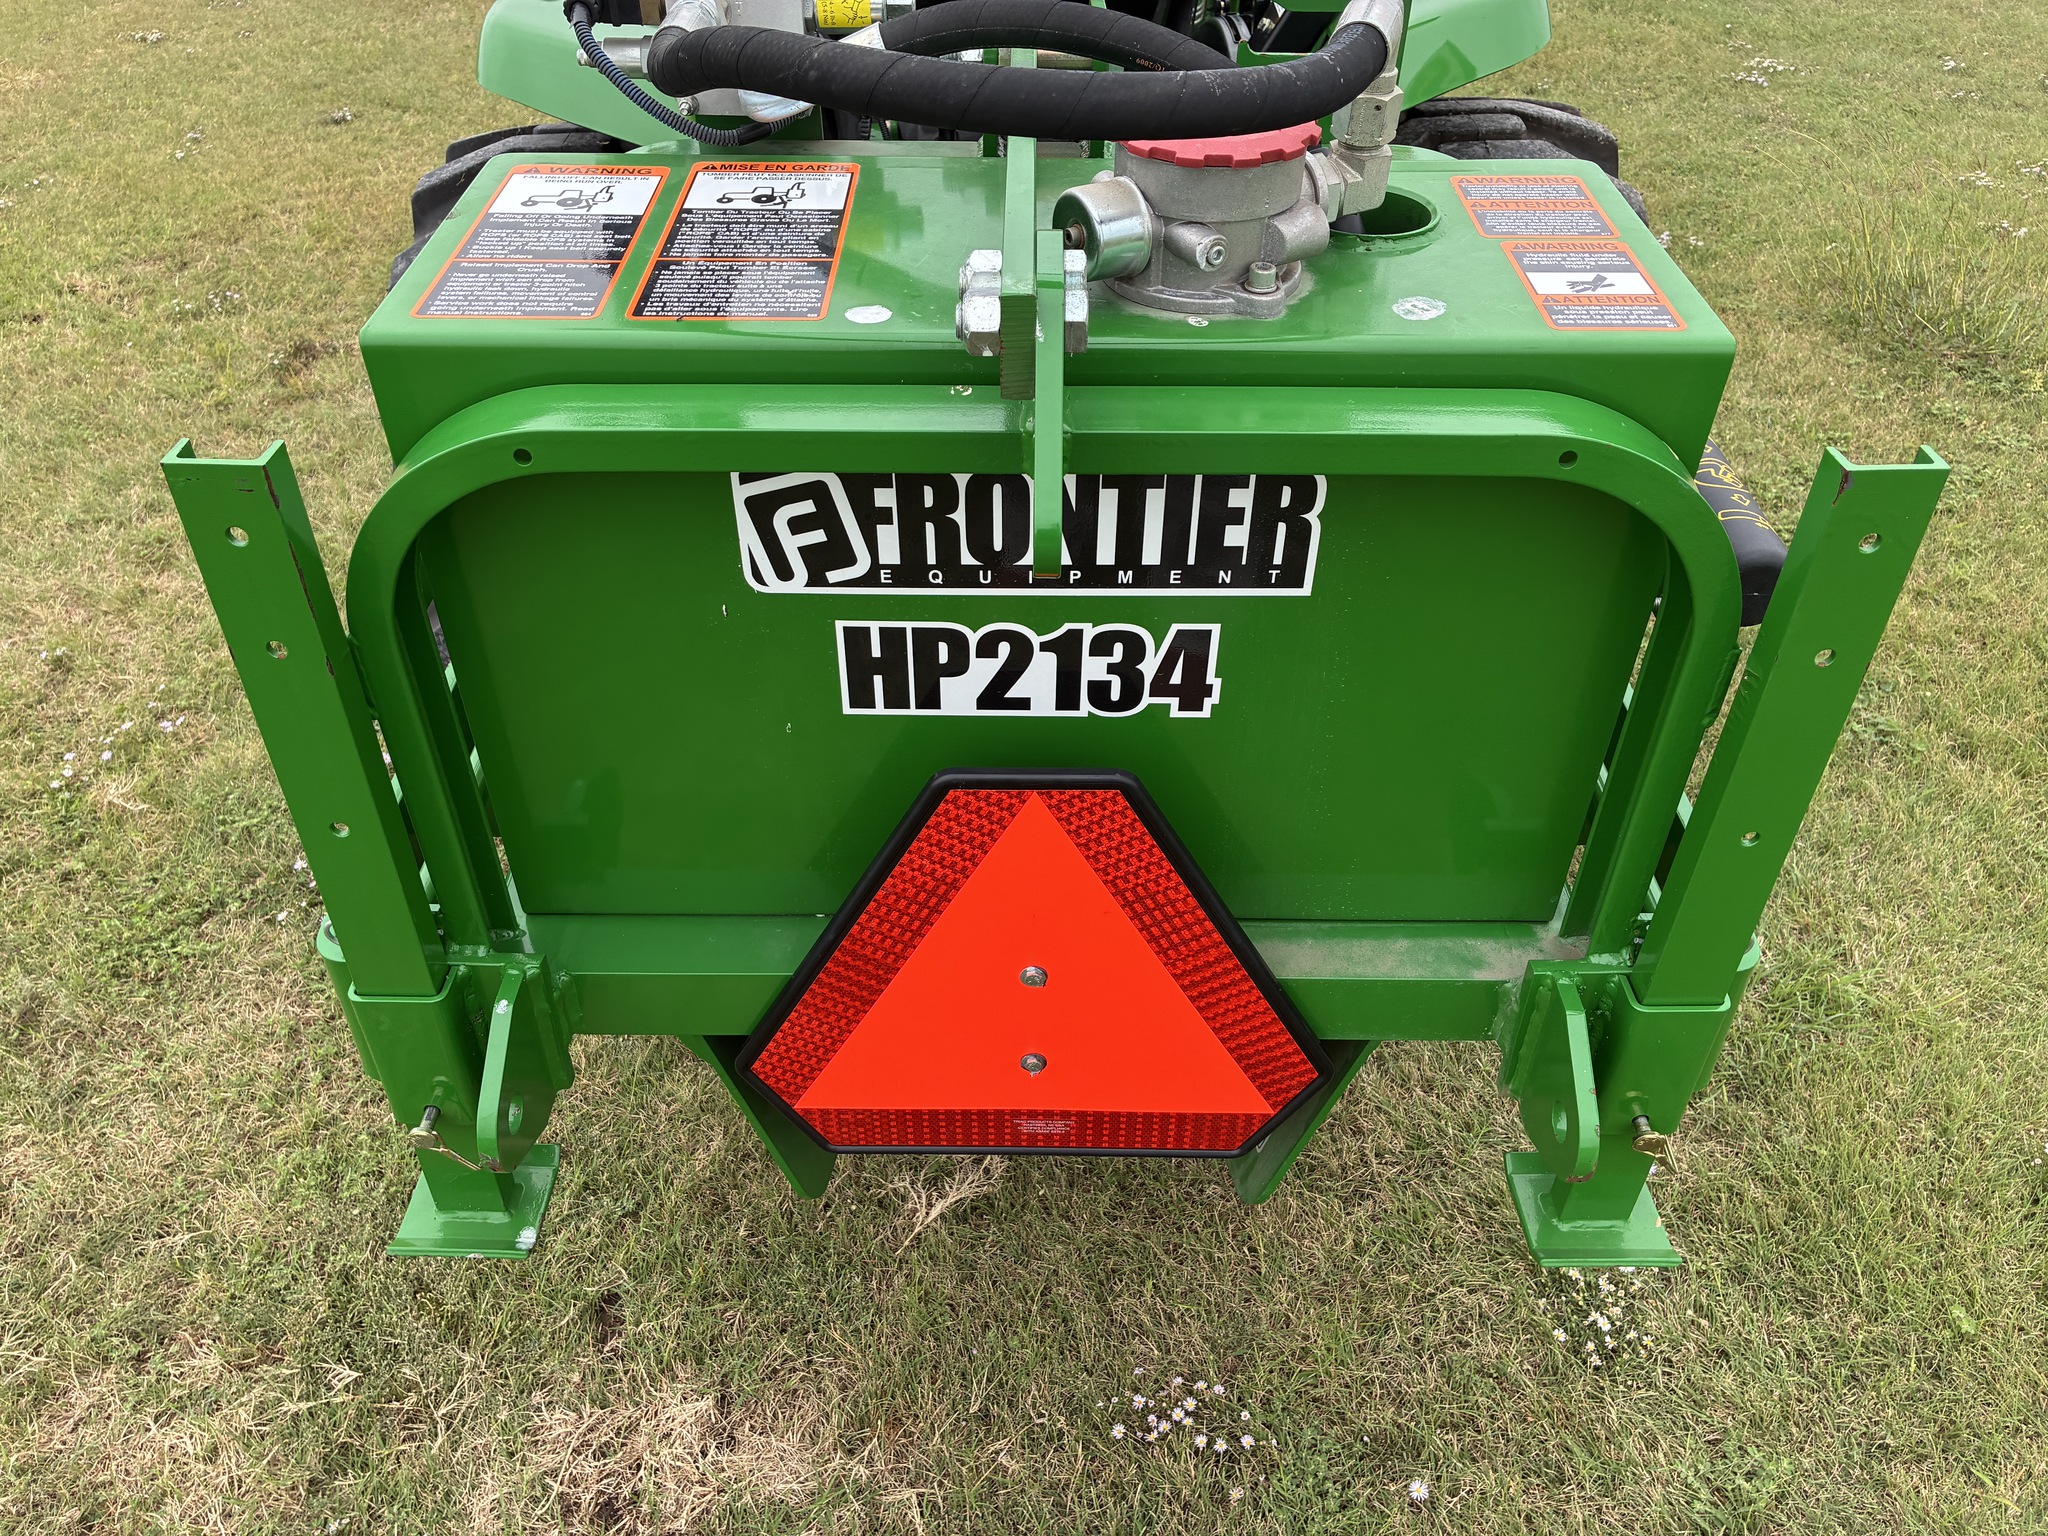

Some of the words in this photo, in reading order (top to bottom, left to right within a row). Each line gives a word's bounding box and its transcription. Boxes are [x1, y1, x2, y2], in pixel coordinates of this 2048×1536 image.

[550, 167, 652, 175] WARNING
[860, 474, 1320, 566] FRONTIER
[880, 569, 1281, 585] EQUIPMENT
[843, 627, 1215, 713] HP2134
